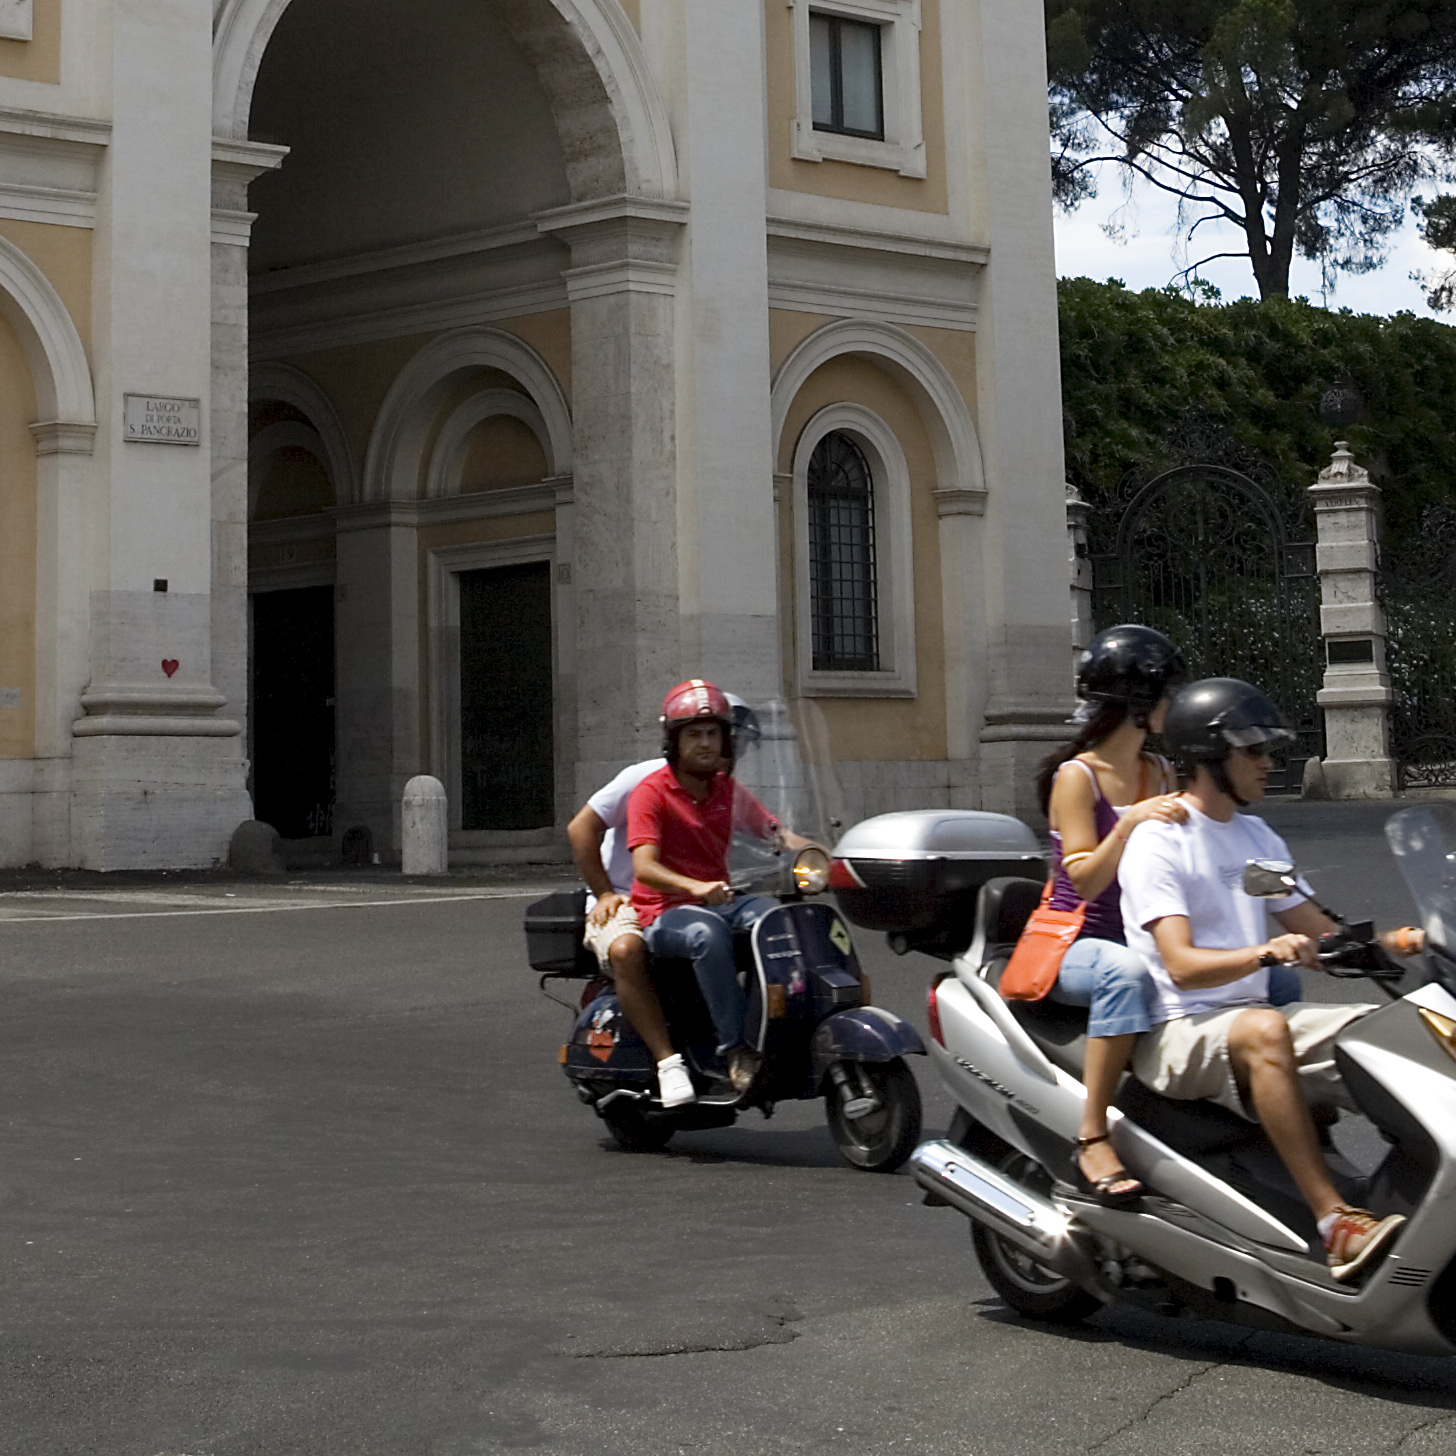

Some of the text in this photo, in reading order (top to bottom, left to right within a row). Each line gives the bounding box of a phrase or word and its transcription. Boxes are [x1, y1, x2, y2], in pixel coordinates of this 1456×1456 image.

[146, 400, 180, 413] LARGO
[145, 414, 182, 425] DI PORTA
[141, 424, 197, 438] PANCRAZIO
